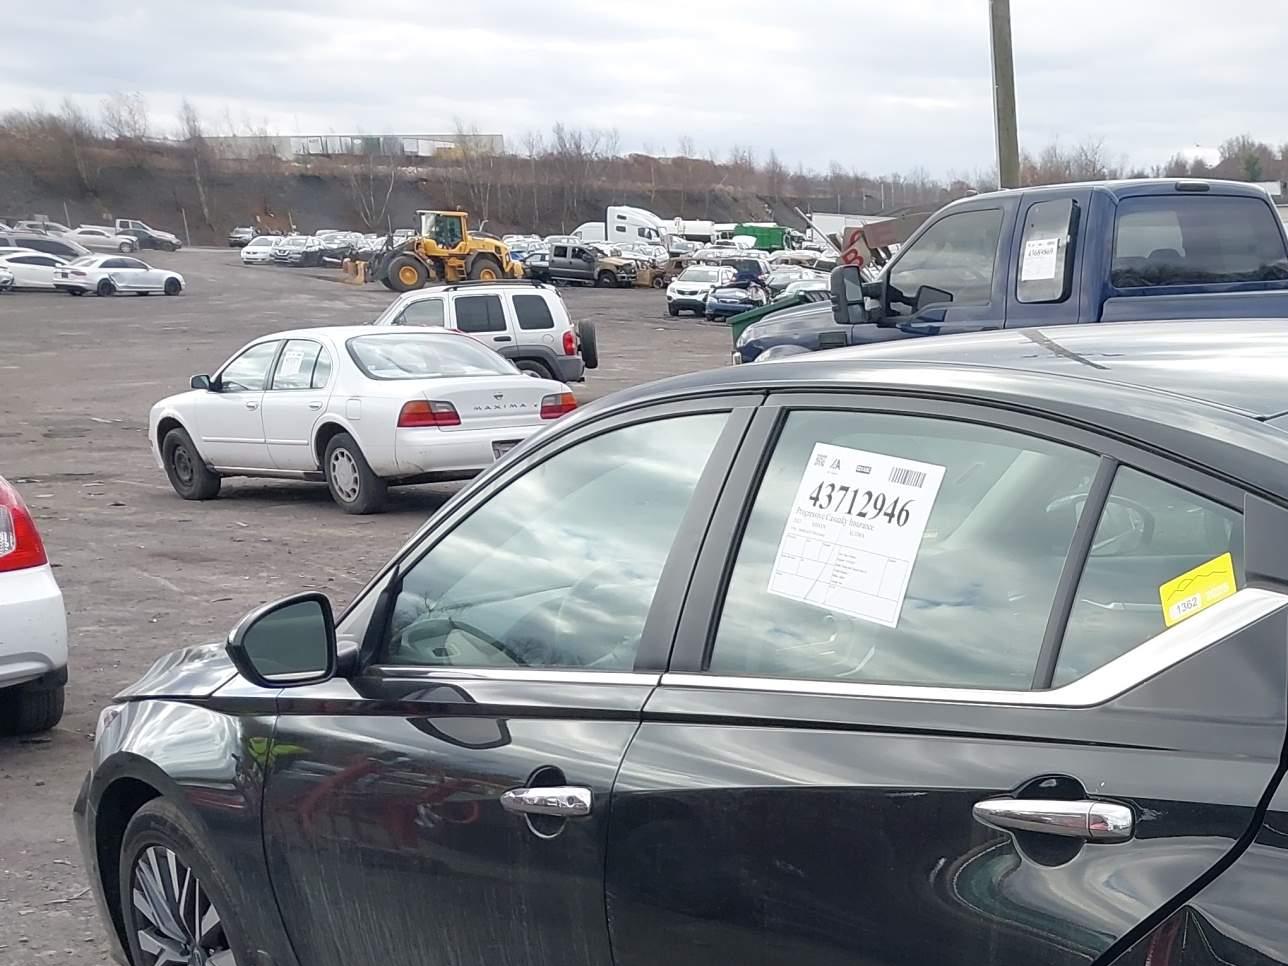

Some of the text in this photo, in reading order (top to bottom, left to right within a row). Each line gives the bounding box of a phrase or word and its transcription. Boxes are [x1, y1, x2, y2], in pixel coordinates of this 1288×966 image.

[473, 403, 528, 411] MAXIMA
[809, 480, 918, 528] 43712946
[1176, 596, 1198, 615] 1362
